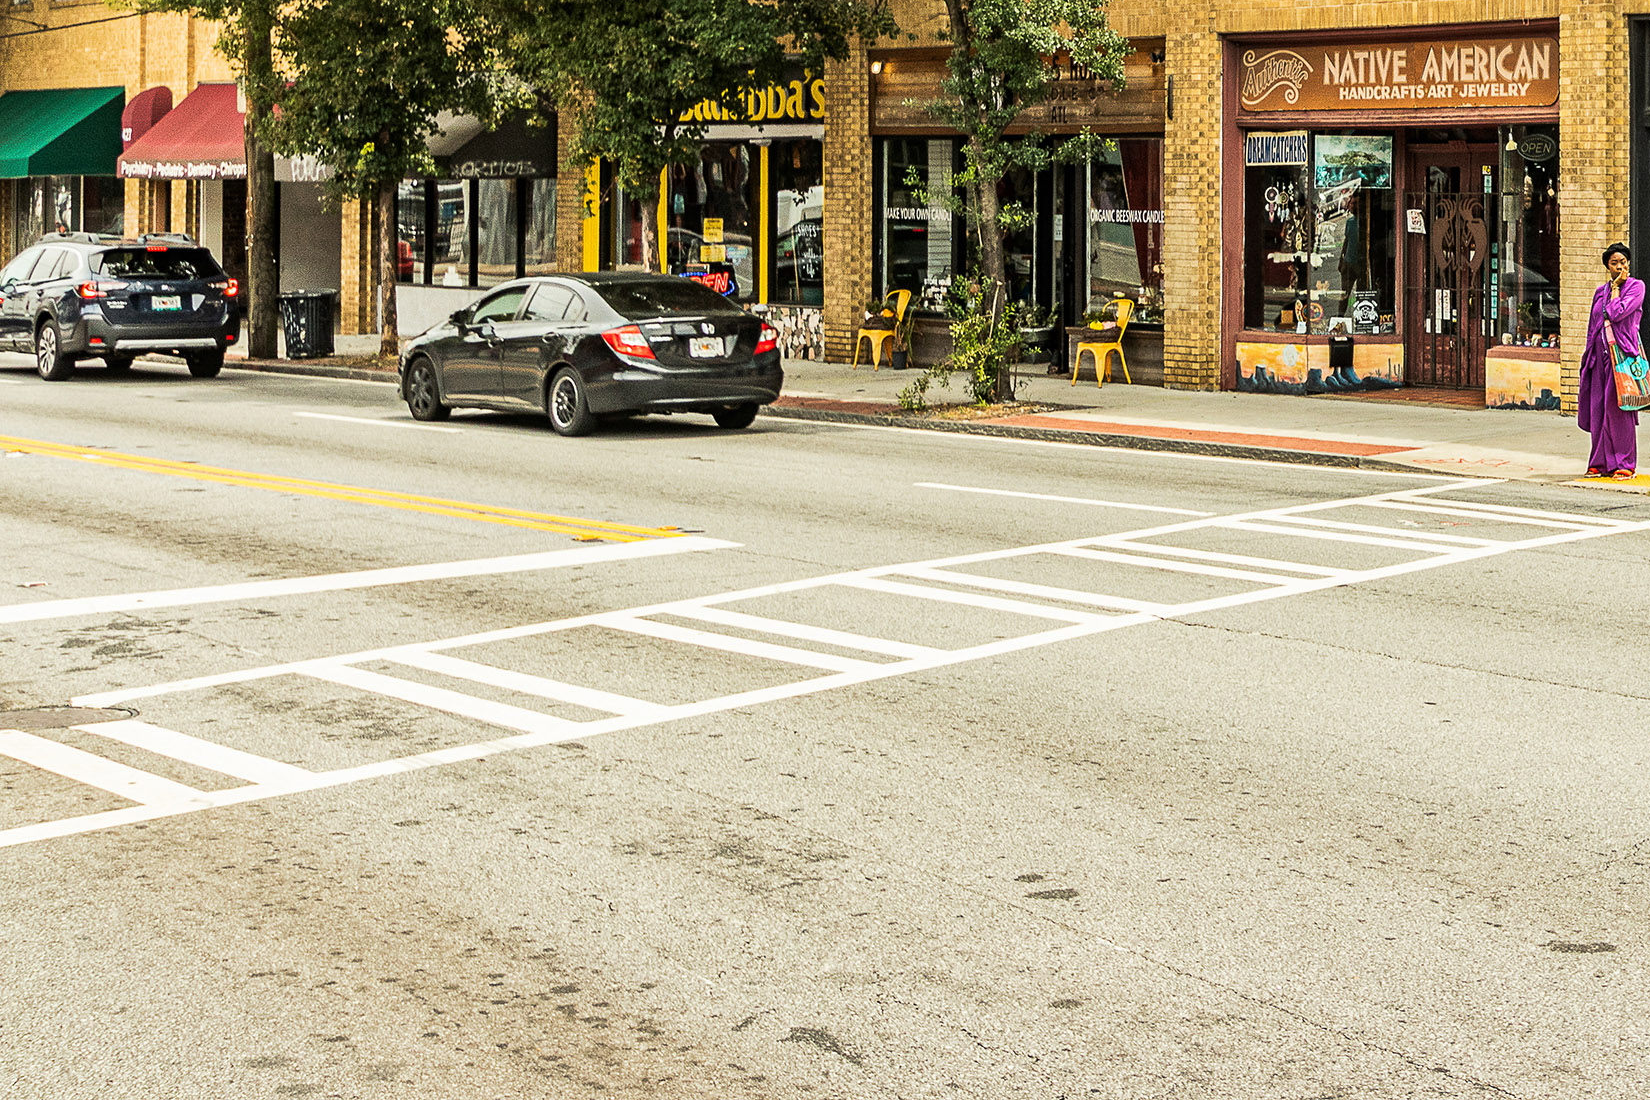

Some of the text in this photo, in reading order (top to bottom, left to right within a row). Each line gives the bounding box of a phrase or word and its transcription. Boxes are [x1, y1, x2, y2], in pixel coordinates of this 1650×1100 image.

[1323, 40, 1551, 85] NATIVE AMERICAN
[1242, 57, 1309, 97] Authentic
[1339, 82, 1532, 100] HANDCRAFTS ART JEWELRY
[1051, 106, 1068, 123] ATL
[1247, 134, 1307, 164] DREAMCATCHERS
[1520, 143, 1552, 154] OPEN
[900, 207, 916, 219] YOUR
[916, 208, 929, 220] OWN
[1090, 208, 1115, 222] ORGANIC
[1116, 209, 1142, 223] BEESWAX
